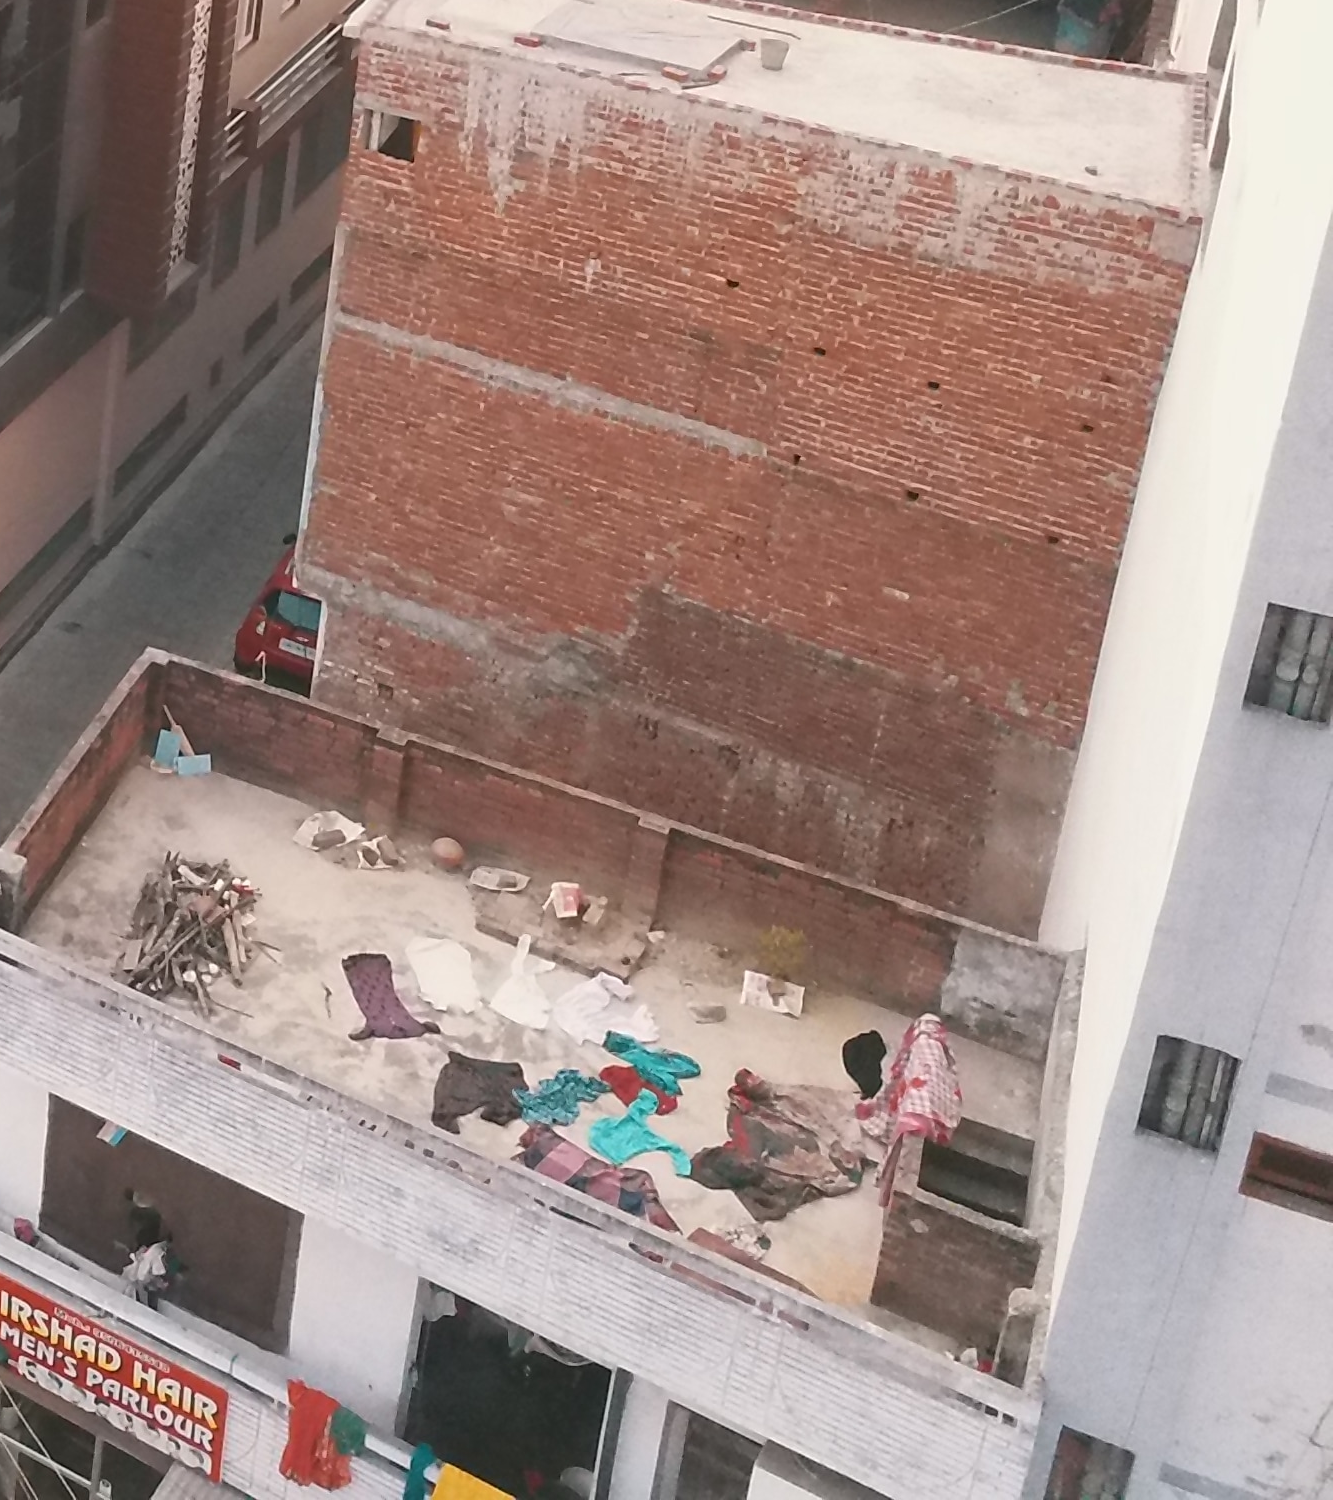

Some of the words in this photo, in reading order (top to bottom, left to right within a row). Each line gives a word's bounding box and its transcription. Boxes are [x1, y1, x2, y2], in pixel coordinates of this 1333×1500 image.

[0, 1290, 123, 1372] IRSHAD
[132, 1359, 218, 1430] HAIR
[0, 1320, 78, 1379] MEN'S
[85, 1366, 214, 1452] PARLOUR
